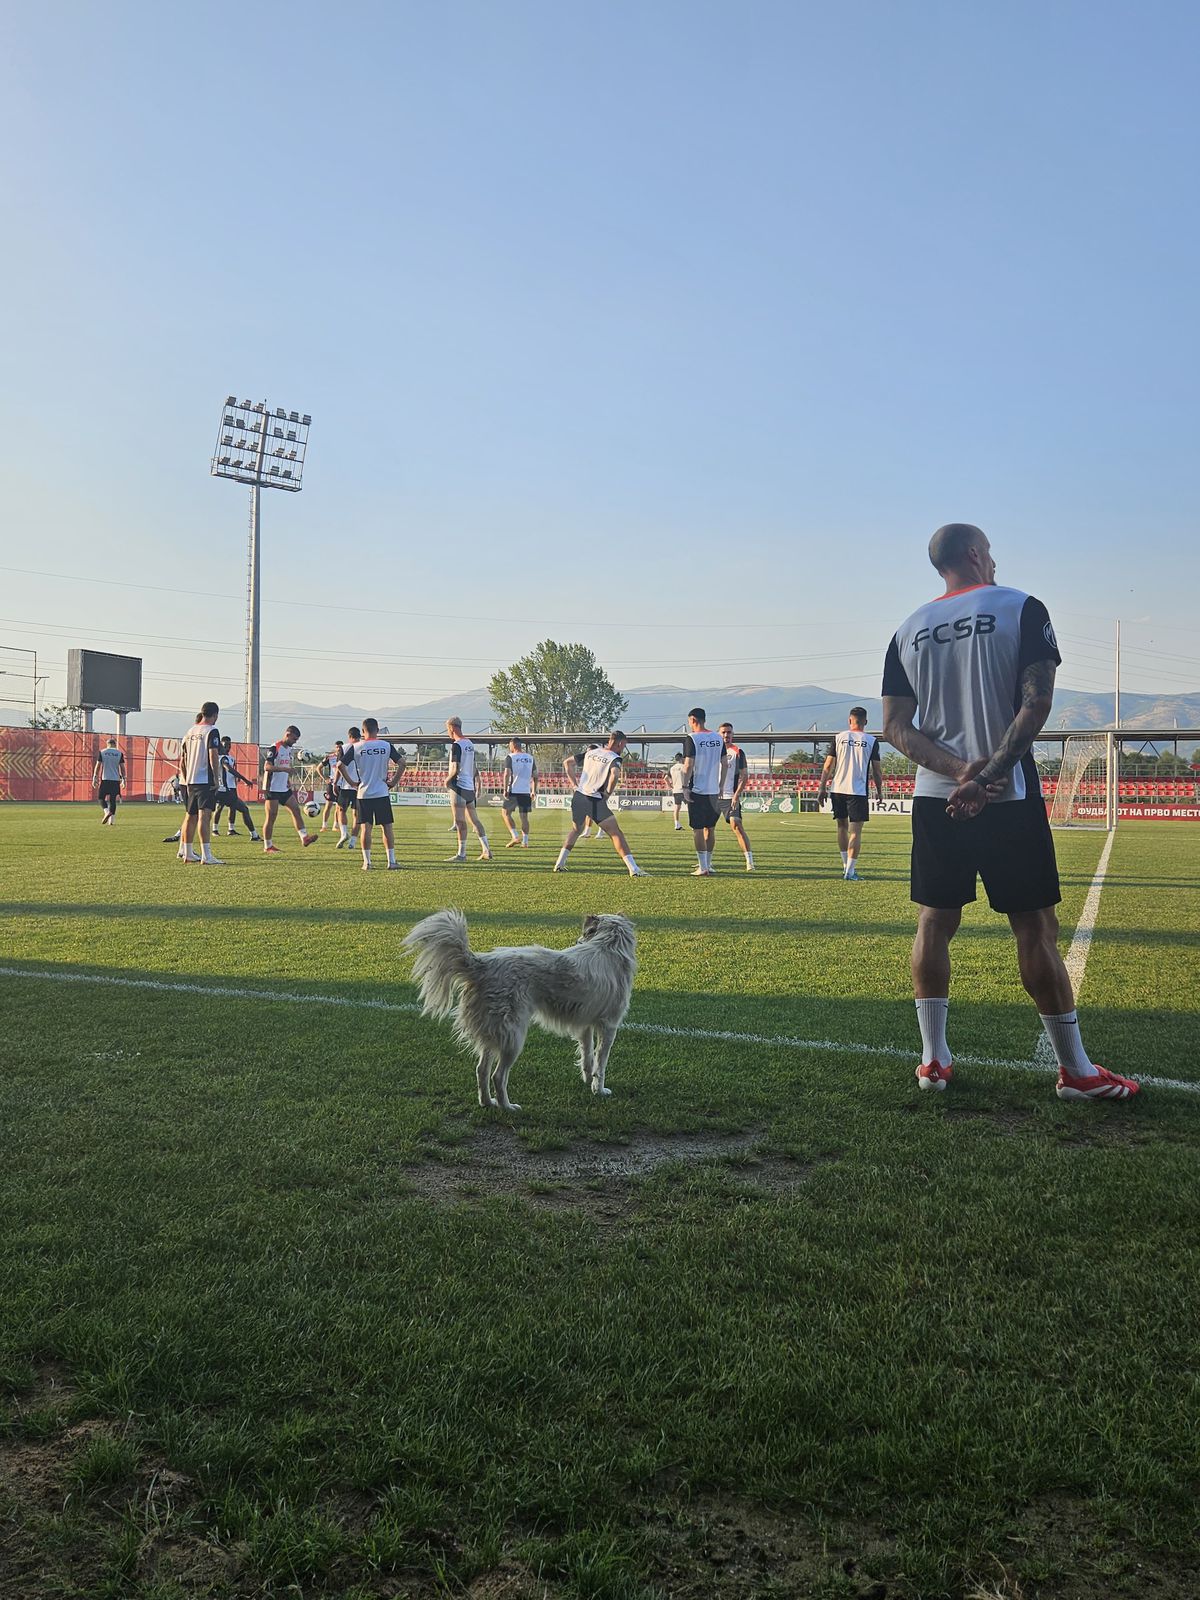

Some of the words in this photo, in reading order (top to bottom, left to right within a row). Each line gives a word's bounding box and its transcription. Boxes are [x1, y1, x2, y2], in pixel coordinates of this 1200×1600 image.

[912, 614, 996, 652] FCSB
[699, 740, 721, 748] FCSB
[360, 748, 386, 756] FCSB
[588, 754, 608, 764] FCSB
[1130, 808, 1142, 816] НА
[1144, 808, 1169, 816] ПРВО
[1172, 809, 1200, 817] МЕСТ
